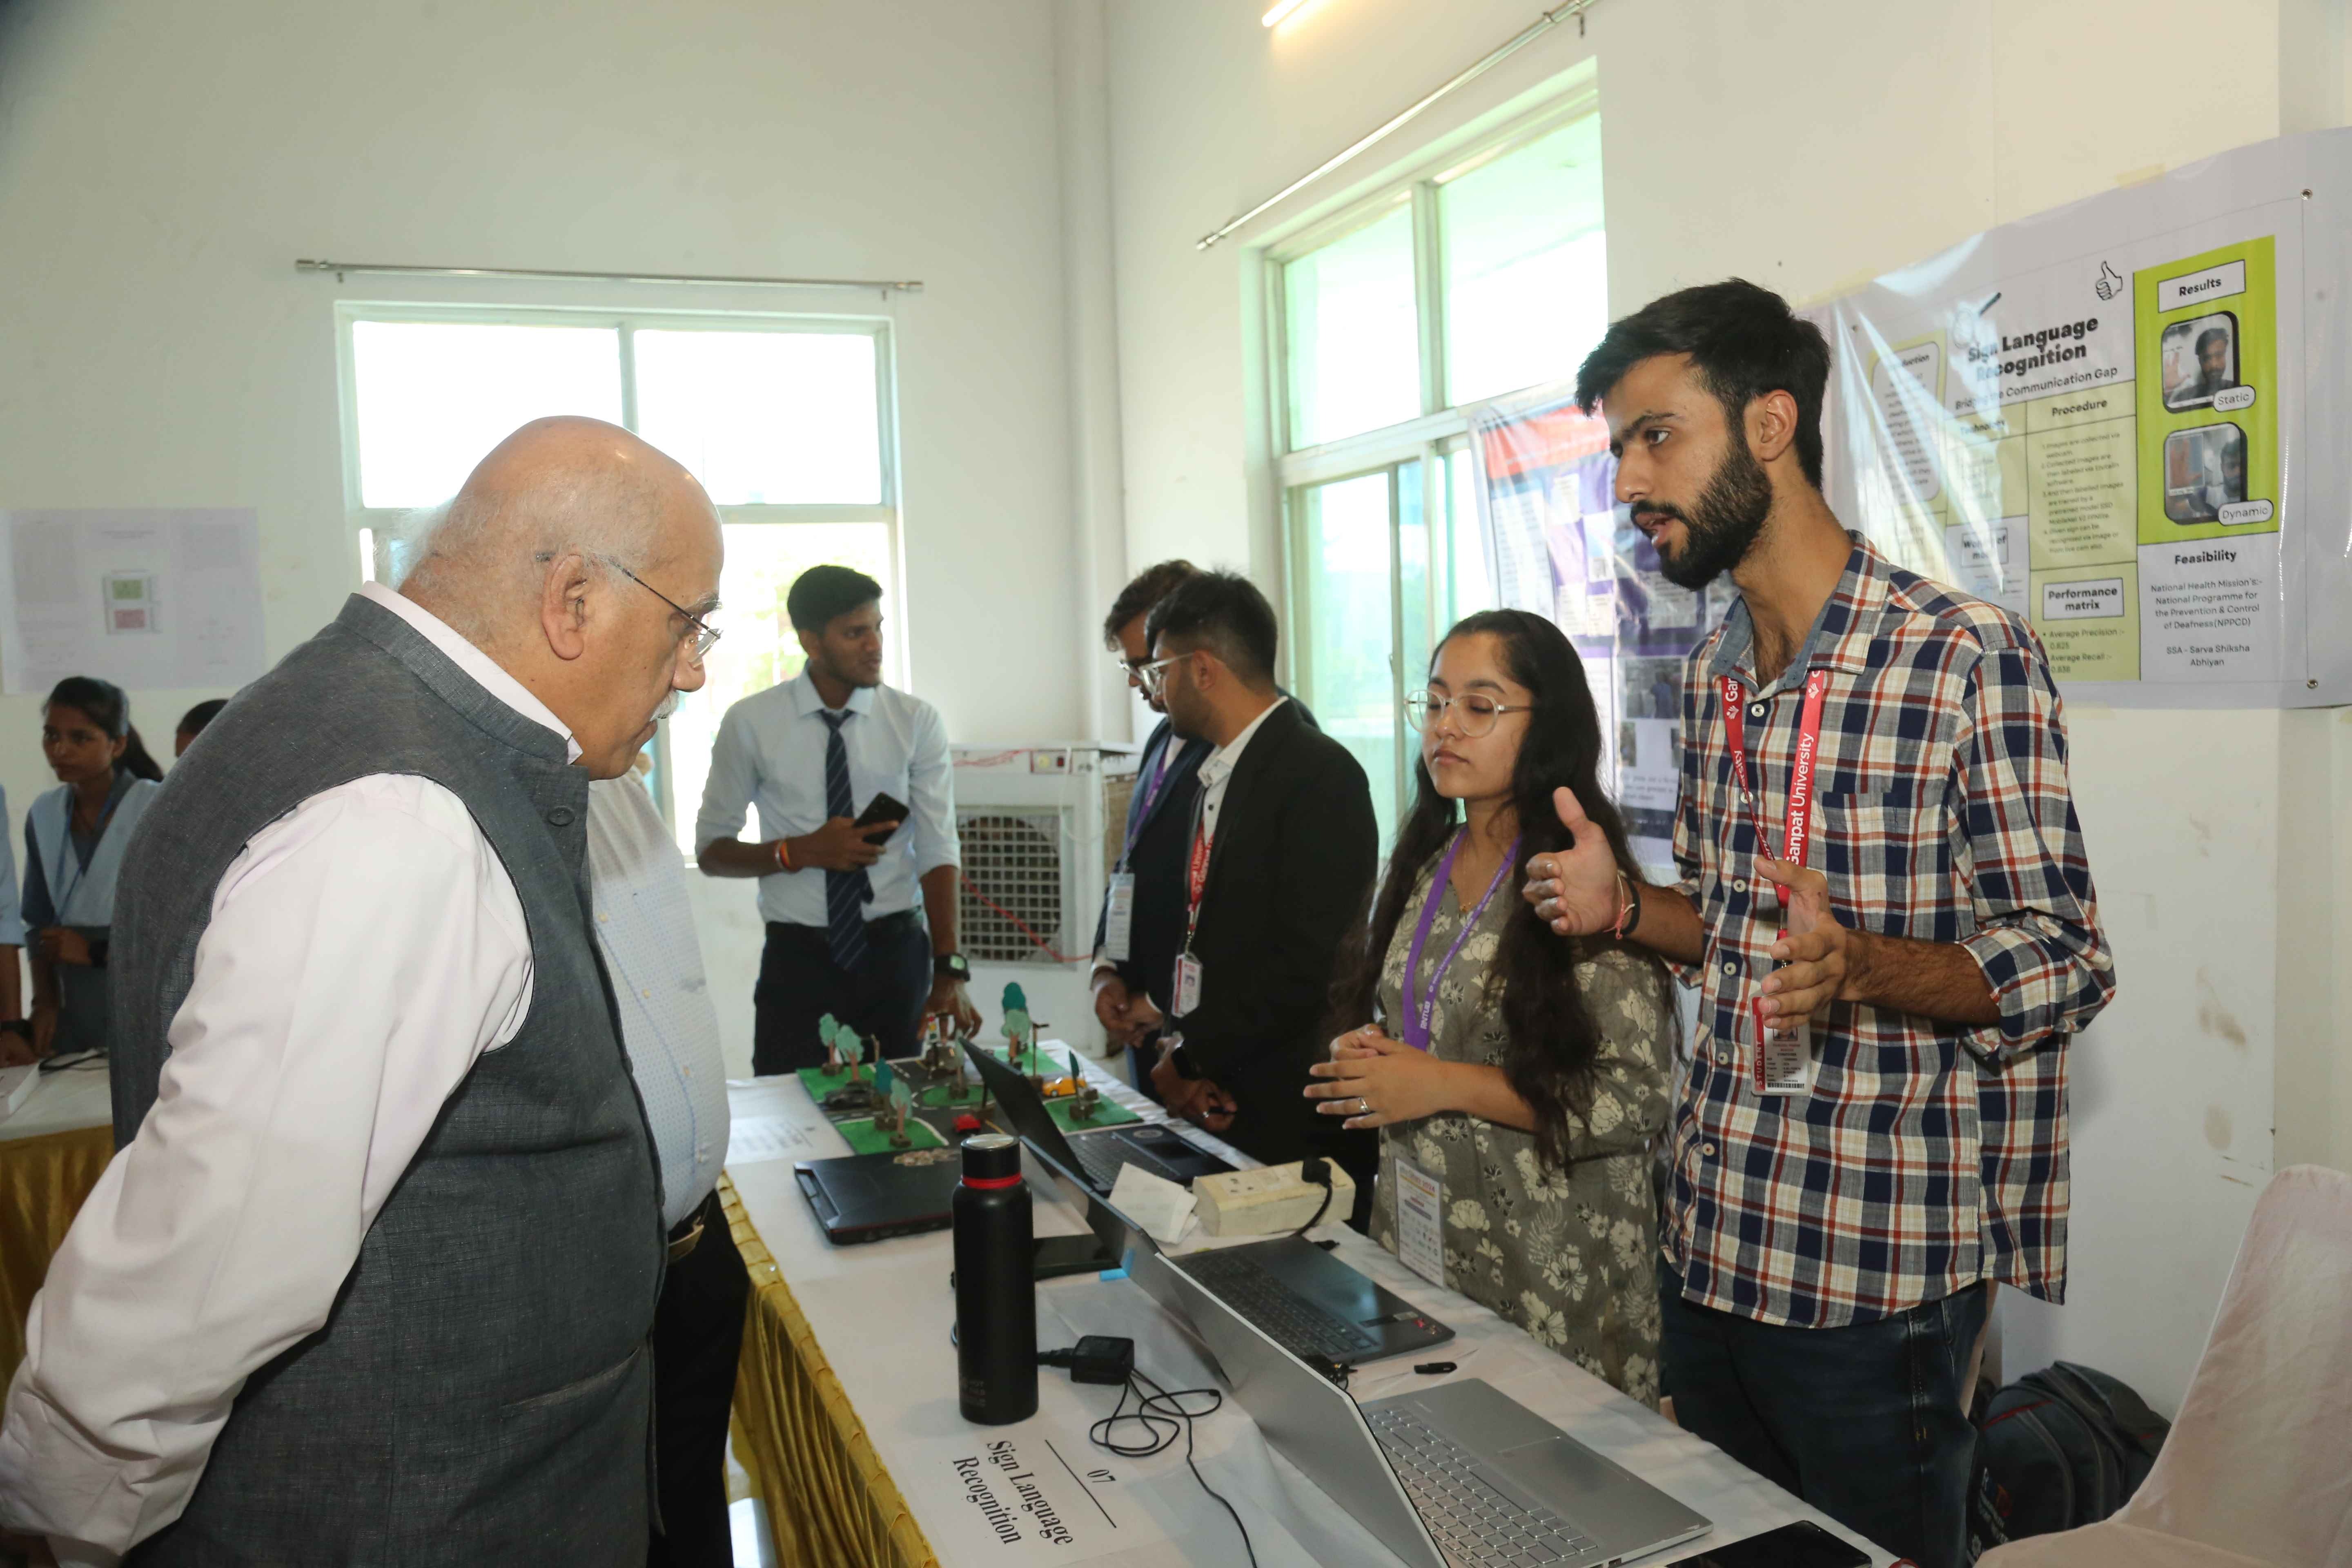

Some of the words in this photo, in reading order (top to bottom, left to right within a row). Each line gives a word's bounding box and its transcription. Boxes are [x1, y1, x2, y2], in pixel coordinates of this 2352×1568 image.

[2179, 278, 2222, 297] Results
[2002, 317, 2098, 351] Language
[1977, 343, 2086, 382] Recognition
[2007, 372, 2091, 397] Communication
[2094, 367, 2118, 379] Gap
[2218, 393, 2250, 406] Static
[2051, 399, 2108, 416] Procedure
[2222, 506, 2267, 521] Dynamic
[2175, 550, 2236, 564] Feasibility
[2151, 583, 2185, 592] National
[2188, 580, 2216, 591] Health
[2049, 588, 2117, 599] Performance
[2156, 595, 2190, 605] National
[2192, 593, 2243, 604] Programme
[2065, 599, 2100, 610] matrix
[2156, 609, 2169, 617] the
[2171, 606, 2217, 617] Prevention
[2219, 605, 2225, 613] &
[2227, 604, 2259, 613] Control
[2050, 630, 2079, 639] Average
[2190, 646, 2214, 654] Sarva
[2215, 644, 2250, 653] Shiksha
[2051, 654, 2080, 663] Average
[2082, 653, 2105, 661] Recall
[2190, 658, 2225, 668] Abhiyan
[1791, 733, 1814, 807] University
[1087, 1469, 1116, 1483] 07
[952, 1455, 1022, 1545] Recognition
[987, 1440, 1020, 1472] Sign
[1009, 1471, 1074, 1546] Language
